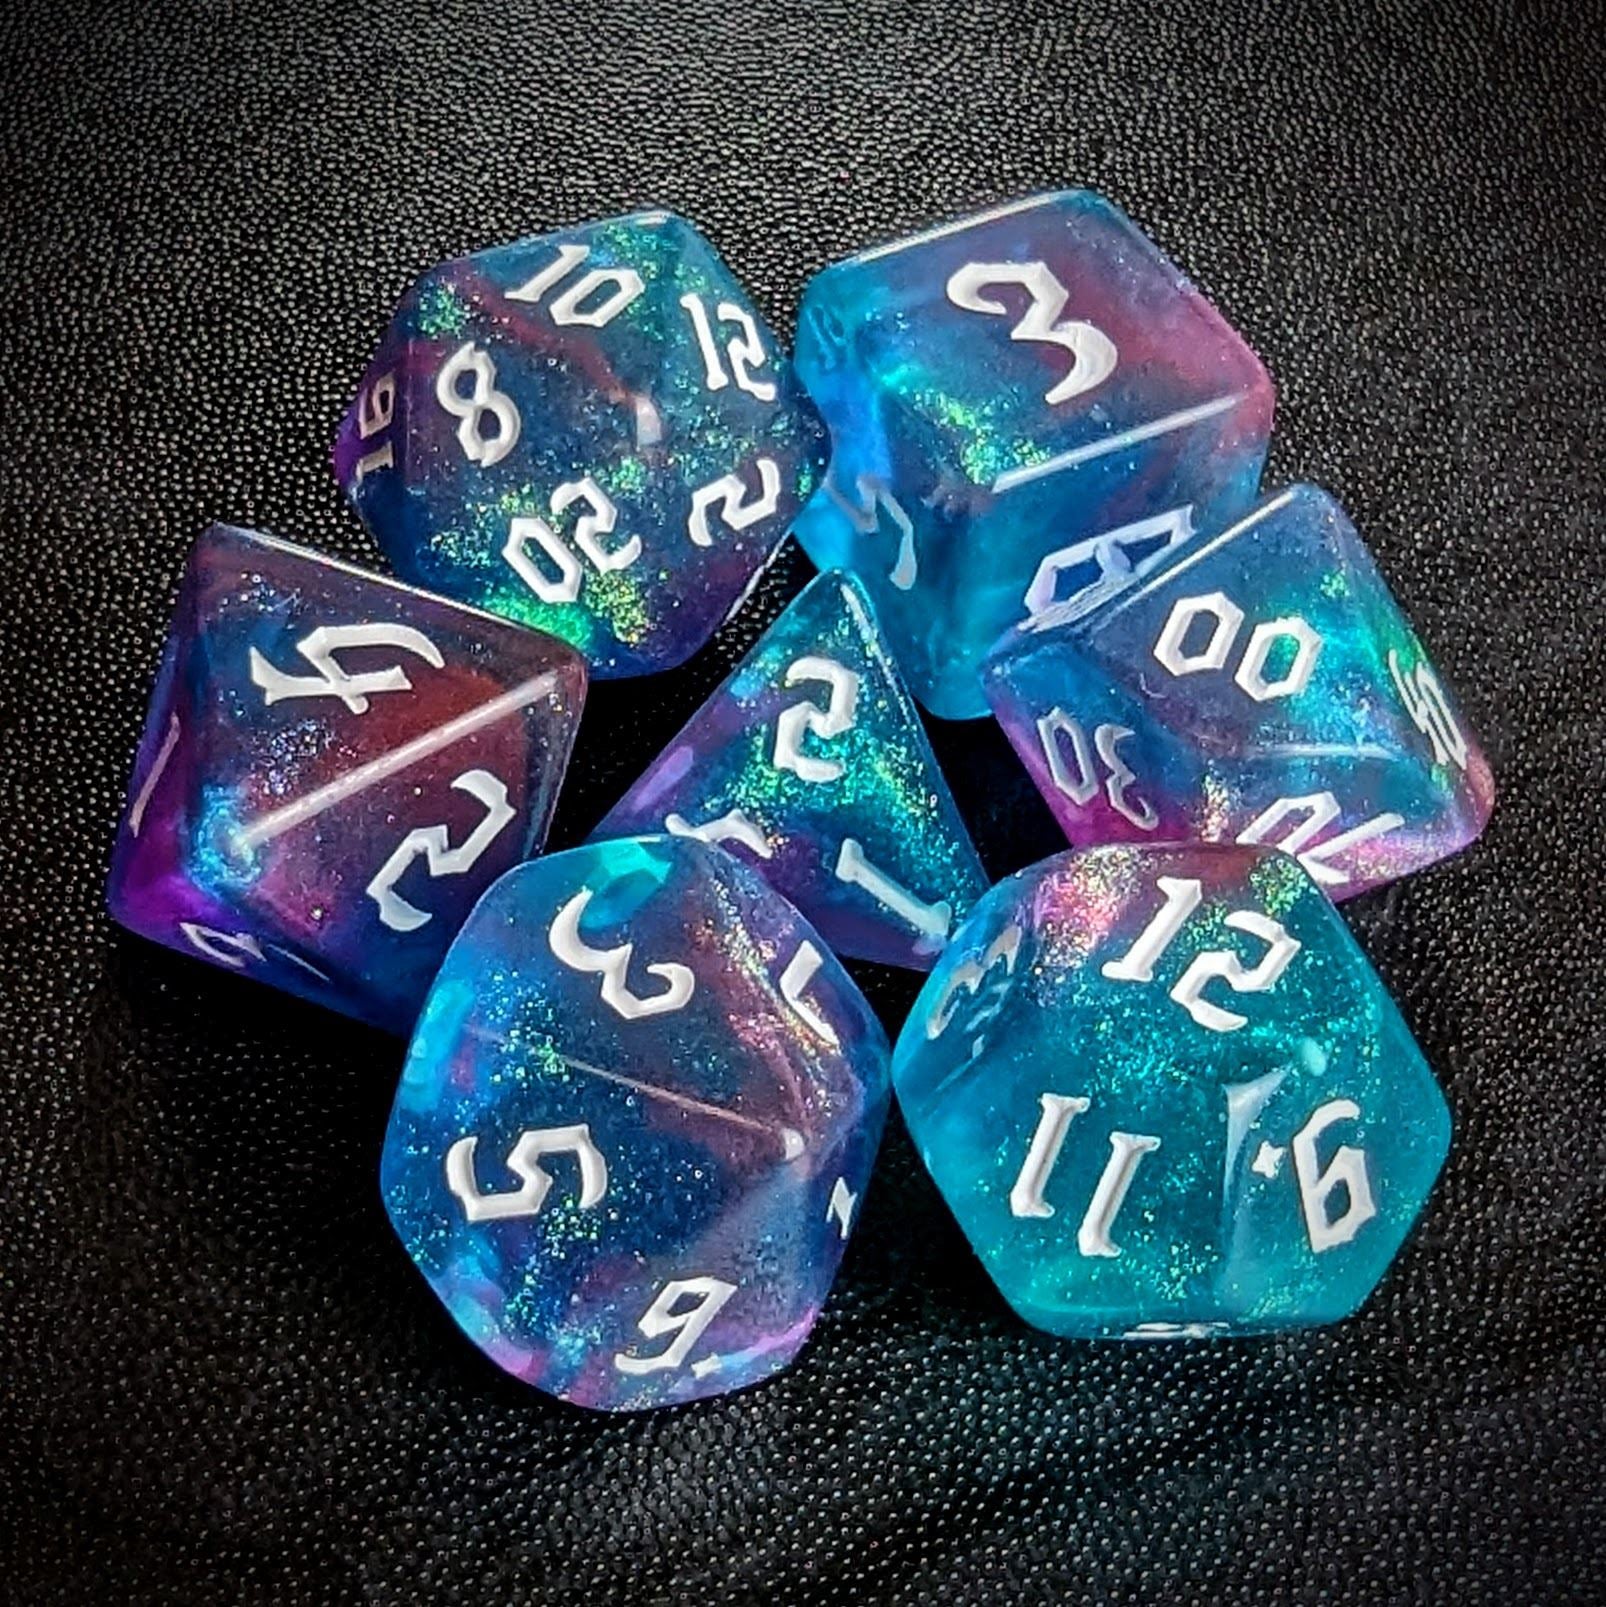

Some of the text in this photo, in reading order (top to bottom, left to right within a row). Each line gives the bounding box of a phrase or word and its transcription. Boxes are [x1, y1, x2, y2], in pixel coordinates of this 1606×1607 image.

[505, 245, 645, 327] 10
[681, 294, 775, 400] 12
[947, 261, 1118, 404] 3
[436, 341, 521, 467] 8
[502, 476, 641, 604] 20
[689, 459, 781, 546] 2
[251, 622, 445, 714] 4
[1154, 592, 1322, 701] 00
[773, 656, 859, 783] 2
[367, 769, 516, 932] 2
[835, 837, 952, 940] 1
[549, 887, 695, 1019] 3
[1101, 876, 1301, 1032] 12
[446, 1124, 608, 1222] 5
[1010, 1093, 1161, 1257] 11
